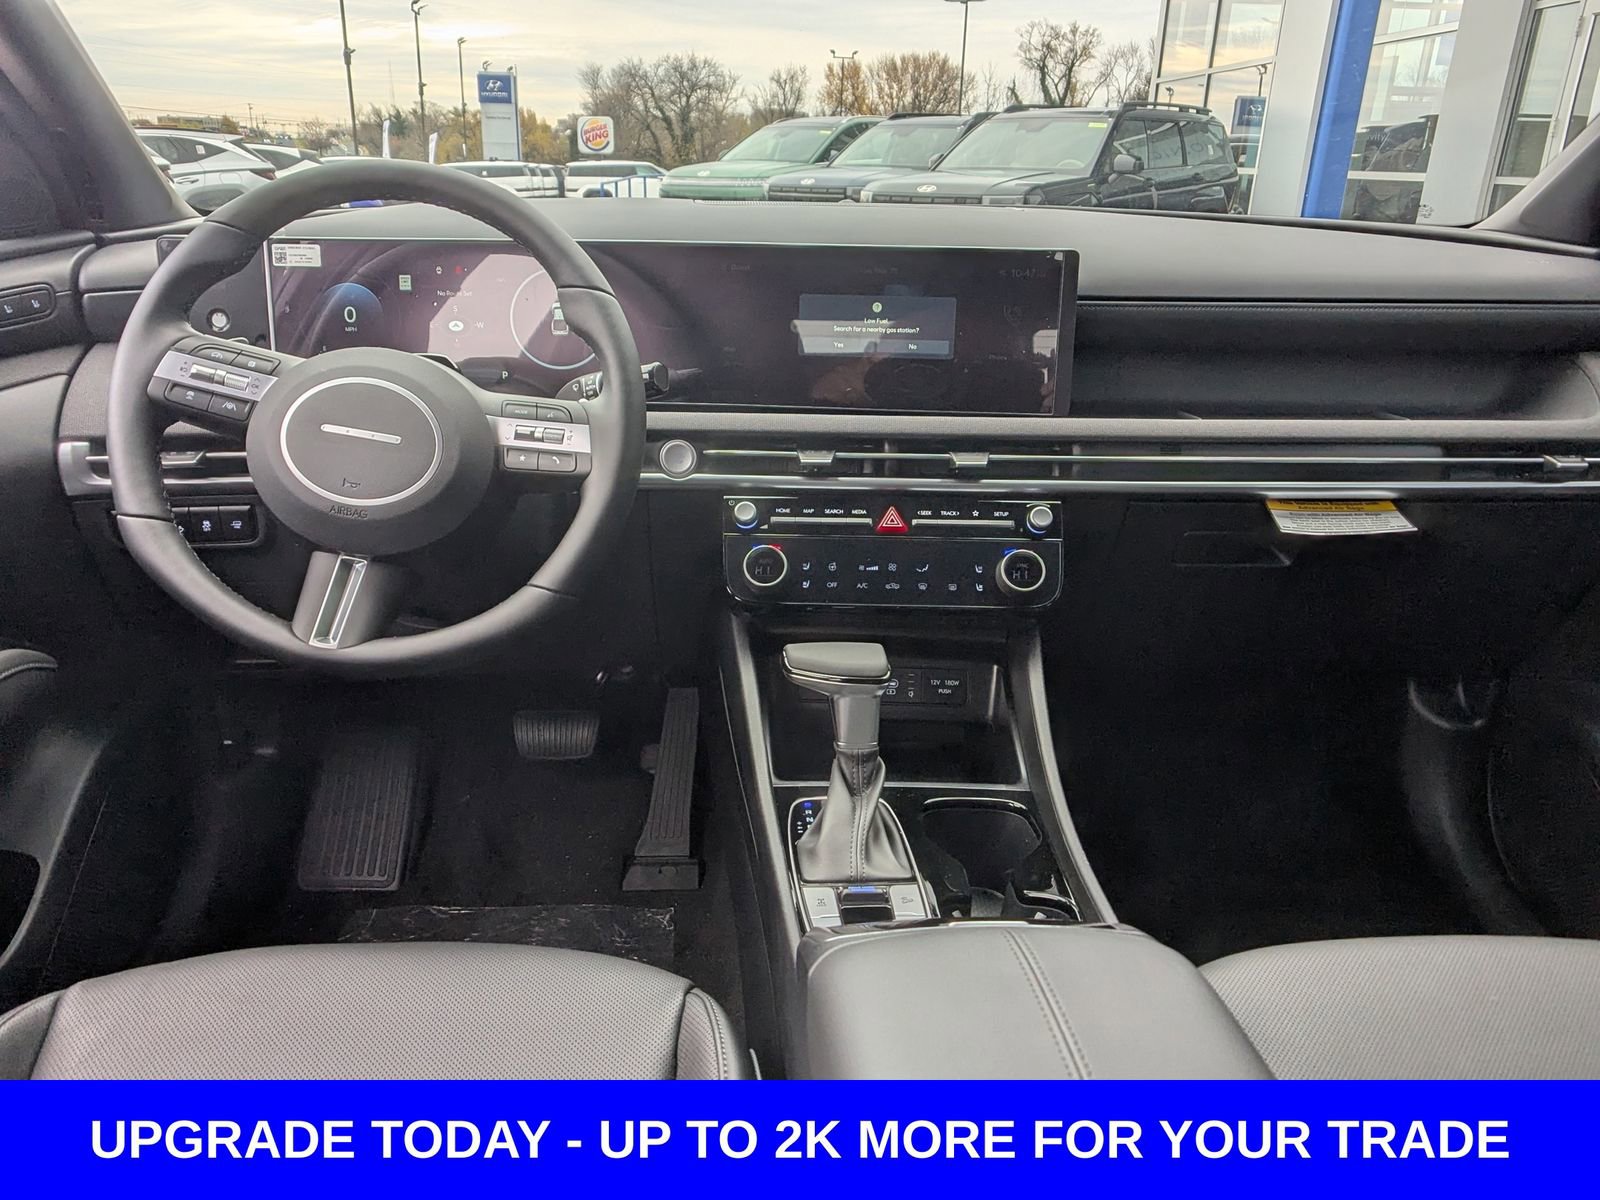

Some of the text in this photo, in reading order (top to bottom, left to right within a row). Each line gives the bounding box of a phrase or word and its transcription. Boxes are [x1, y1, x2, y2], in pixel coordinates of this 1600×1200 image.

[584, 124, 608, 135] BURGER
[585, 130, 608, 144] KING
[344, 306, 356, 323] 0
[866, 326, 886, 334] nearby
[502, 371, 508, 379] P
[329, 505, 368, 518] AIRBAG
